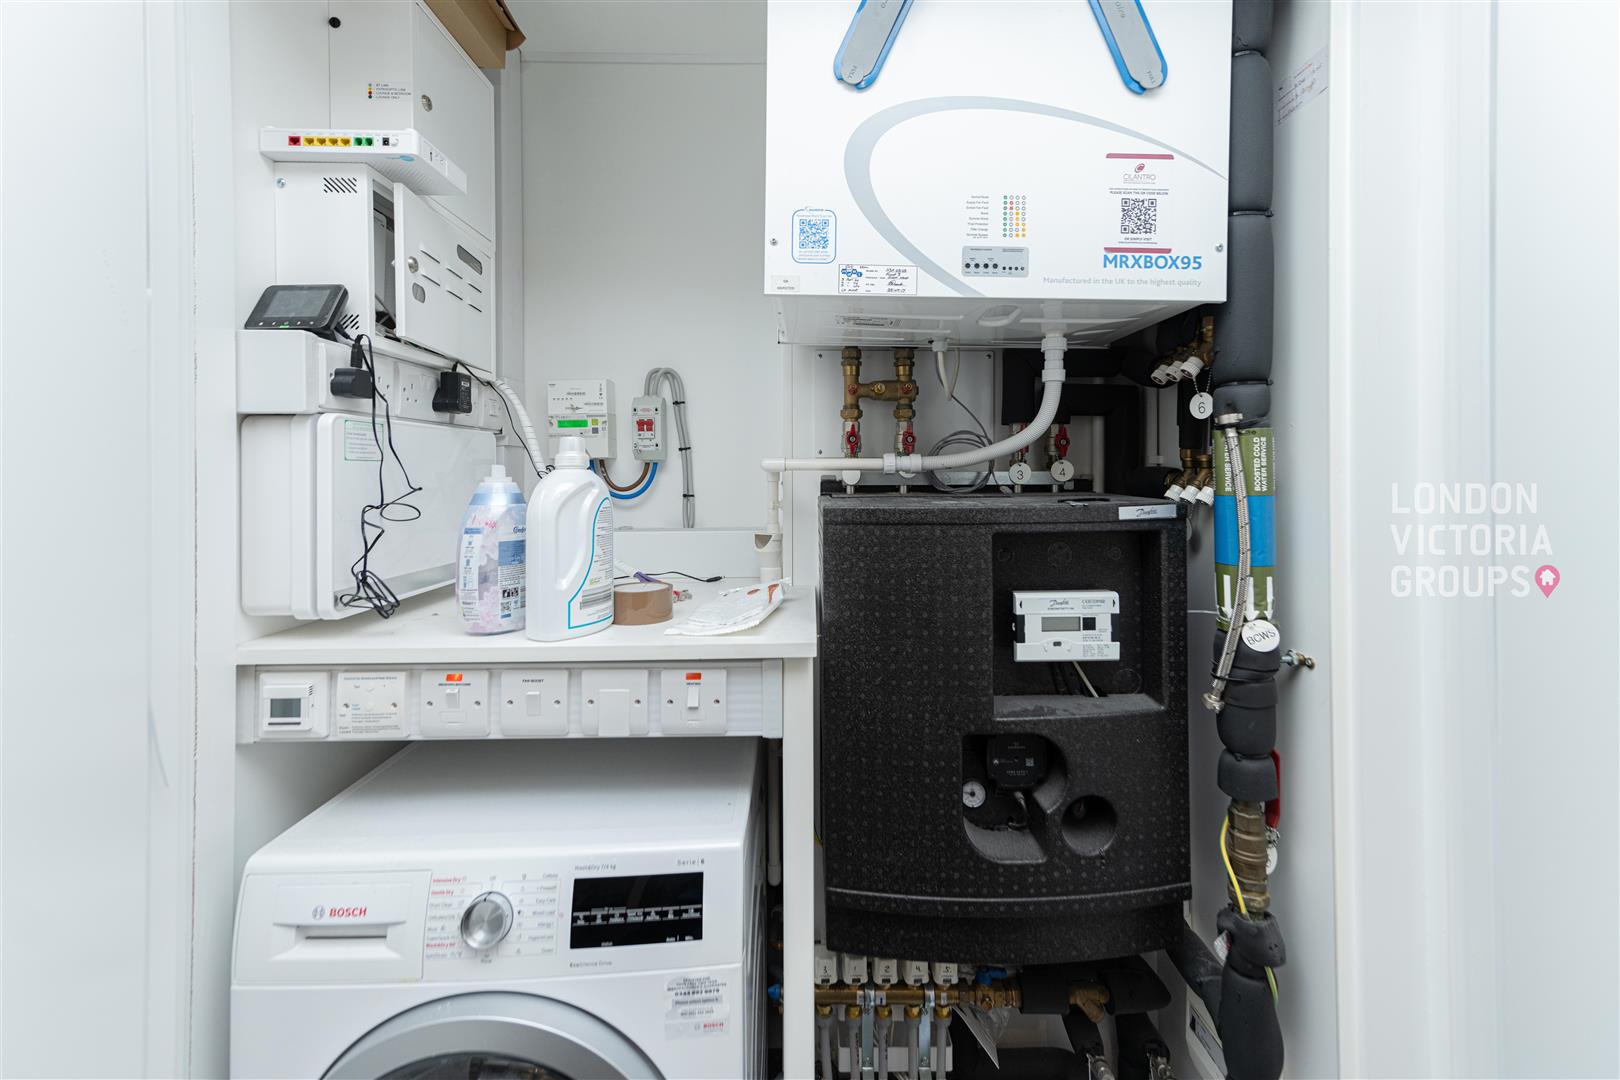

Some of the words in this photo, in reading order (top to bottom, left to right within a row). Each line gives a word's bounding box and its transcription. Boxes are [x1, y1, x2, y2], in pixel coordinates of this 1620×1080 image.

[1103, 254, 1202, 270] MRXBOX95
[1043, 277, 1092, 285] Manufactured
[1150, 279, 1176, 288] highest
[1177, 280, 1202, 288] quality
[1198, 401, 1206, 414] 6
[1253, 436, 1261, 457] COLD
[1016, 469, 1024, 481] 3
[1059, 467, 1066, 477] 4
[1253, 458, 1261, 492] BOOSTED
[1246, 631, 1276, 646] BCWS
[328, 906, 367, 918] BOSCH
